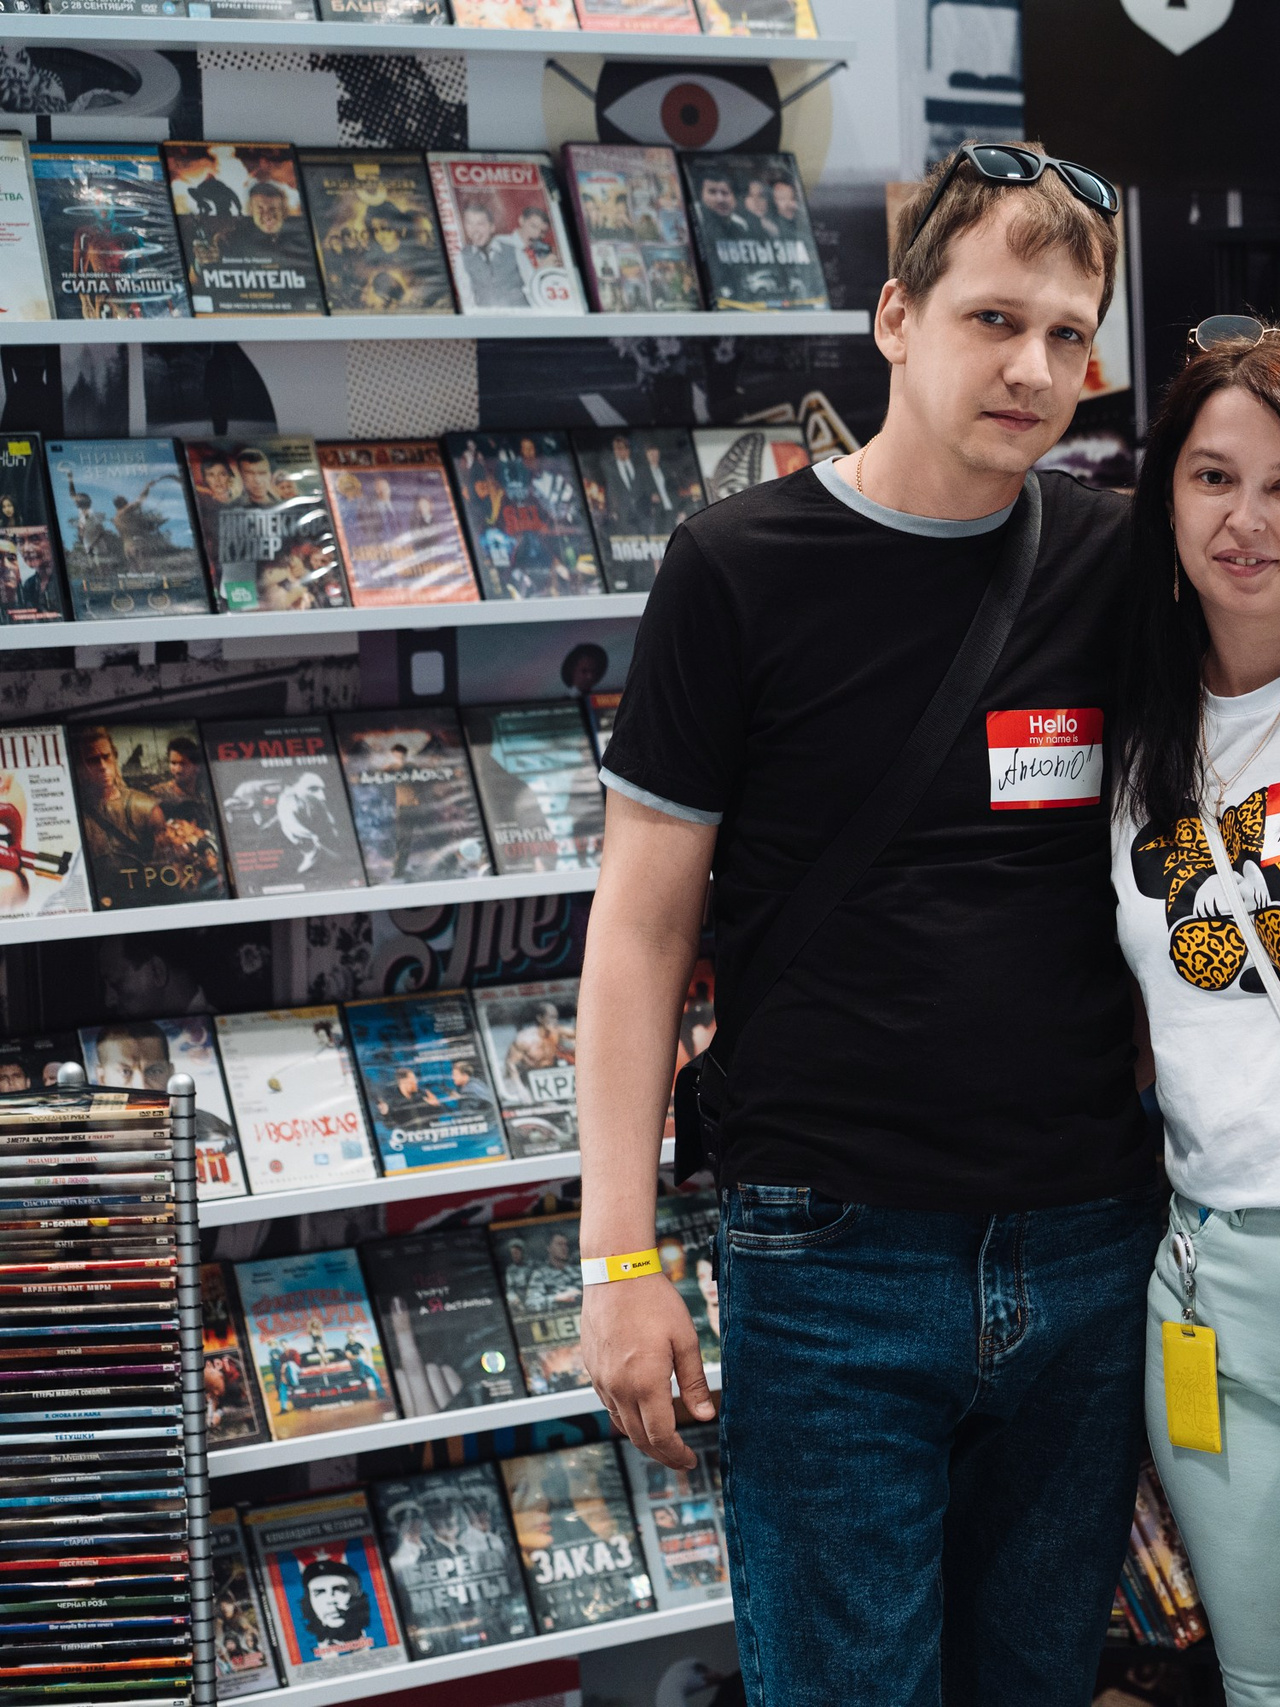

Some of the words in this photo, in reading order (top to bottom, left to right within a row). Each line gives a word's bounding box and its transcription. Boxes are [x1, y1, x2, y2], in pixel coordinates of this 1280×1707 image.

[455, 165, 533, 184] COMEDY
[716, 239, 773, 265] ЦВЕТЫ
[203, 269, 306, 289] МСТИТЕЛЬ
[61, 280, 110, 294] СИЛА
[546, 287, 570, 300] 33
[79, 452, 145, 465] НИЧЬЯ
[84, 464, 149, 478] ЗЕМЛЯ
[1029, 715, 1078, 734] Hello
[1029, 736, 1043, 746] my
[1045, 736, 1070, 744] name
[1072, 734, 1079, 743] is
[217, 737, 325, 762] БУМЕР
[120, 865, 196, 890] ТРОЯ
[10, 1136, 30, 1144] МЕТРА
[53, 1219, 88, 1228] БОЛЬШЕ
[632, 1260, 651, 1269] БАНК
[22, 1285, 84, 1293] ПАРАЛЛЕЛЬНЫЕ
[86, 1283, 112, 1291] МИРЫ
[55, 1433, 95, 1441] ТЕТУШКИ
[63, 1538, 95, 1547] СТАРТАП
[530, 1534, 634, 1585] ЗАКАЗ
[57, 1601, 86, 1609] ЧЕРНАЯ
[88, 1600, 108, 1608] РОЗА
